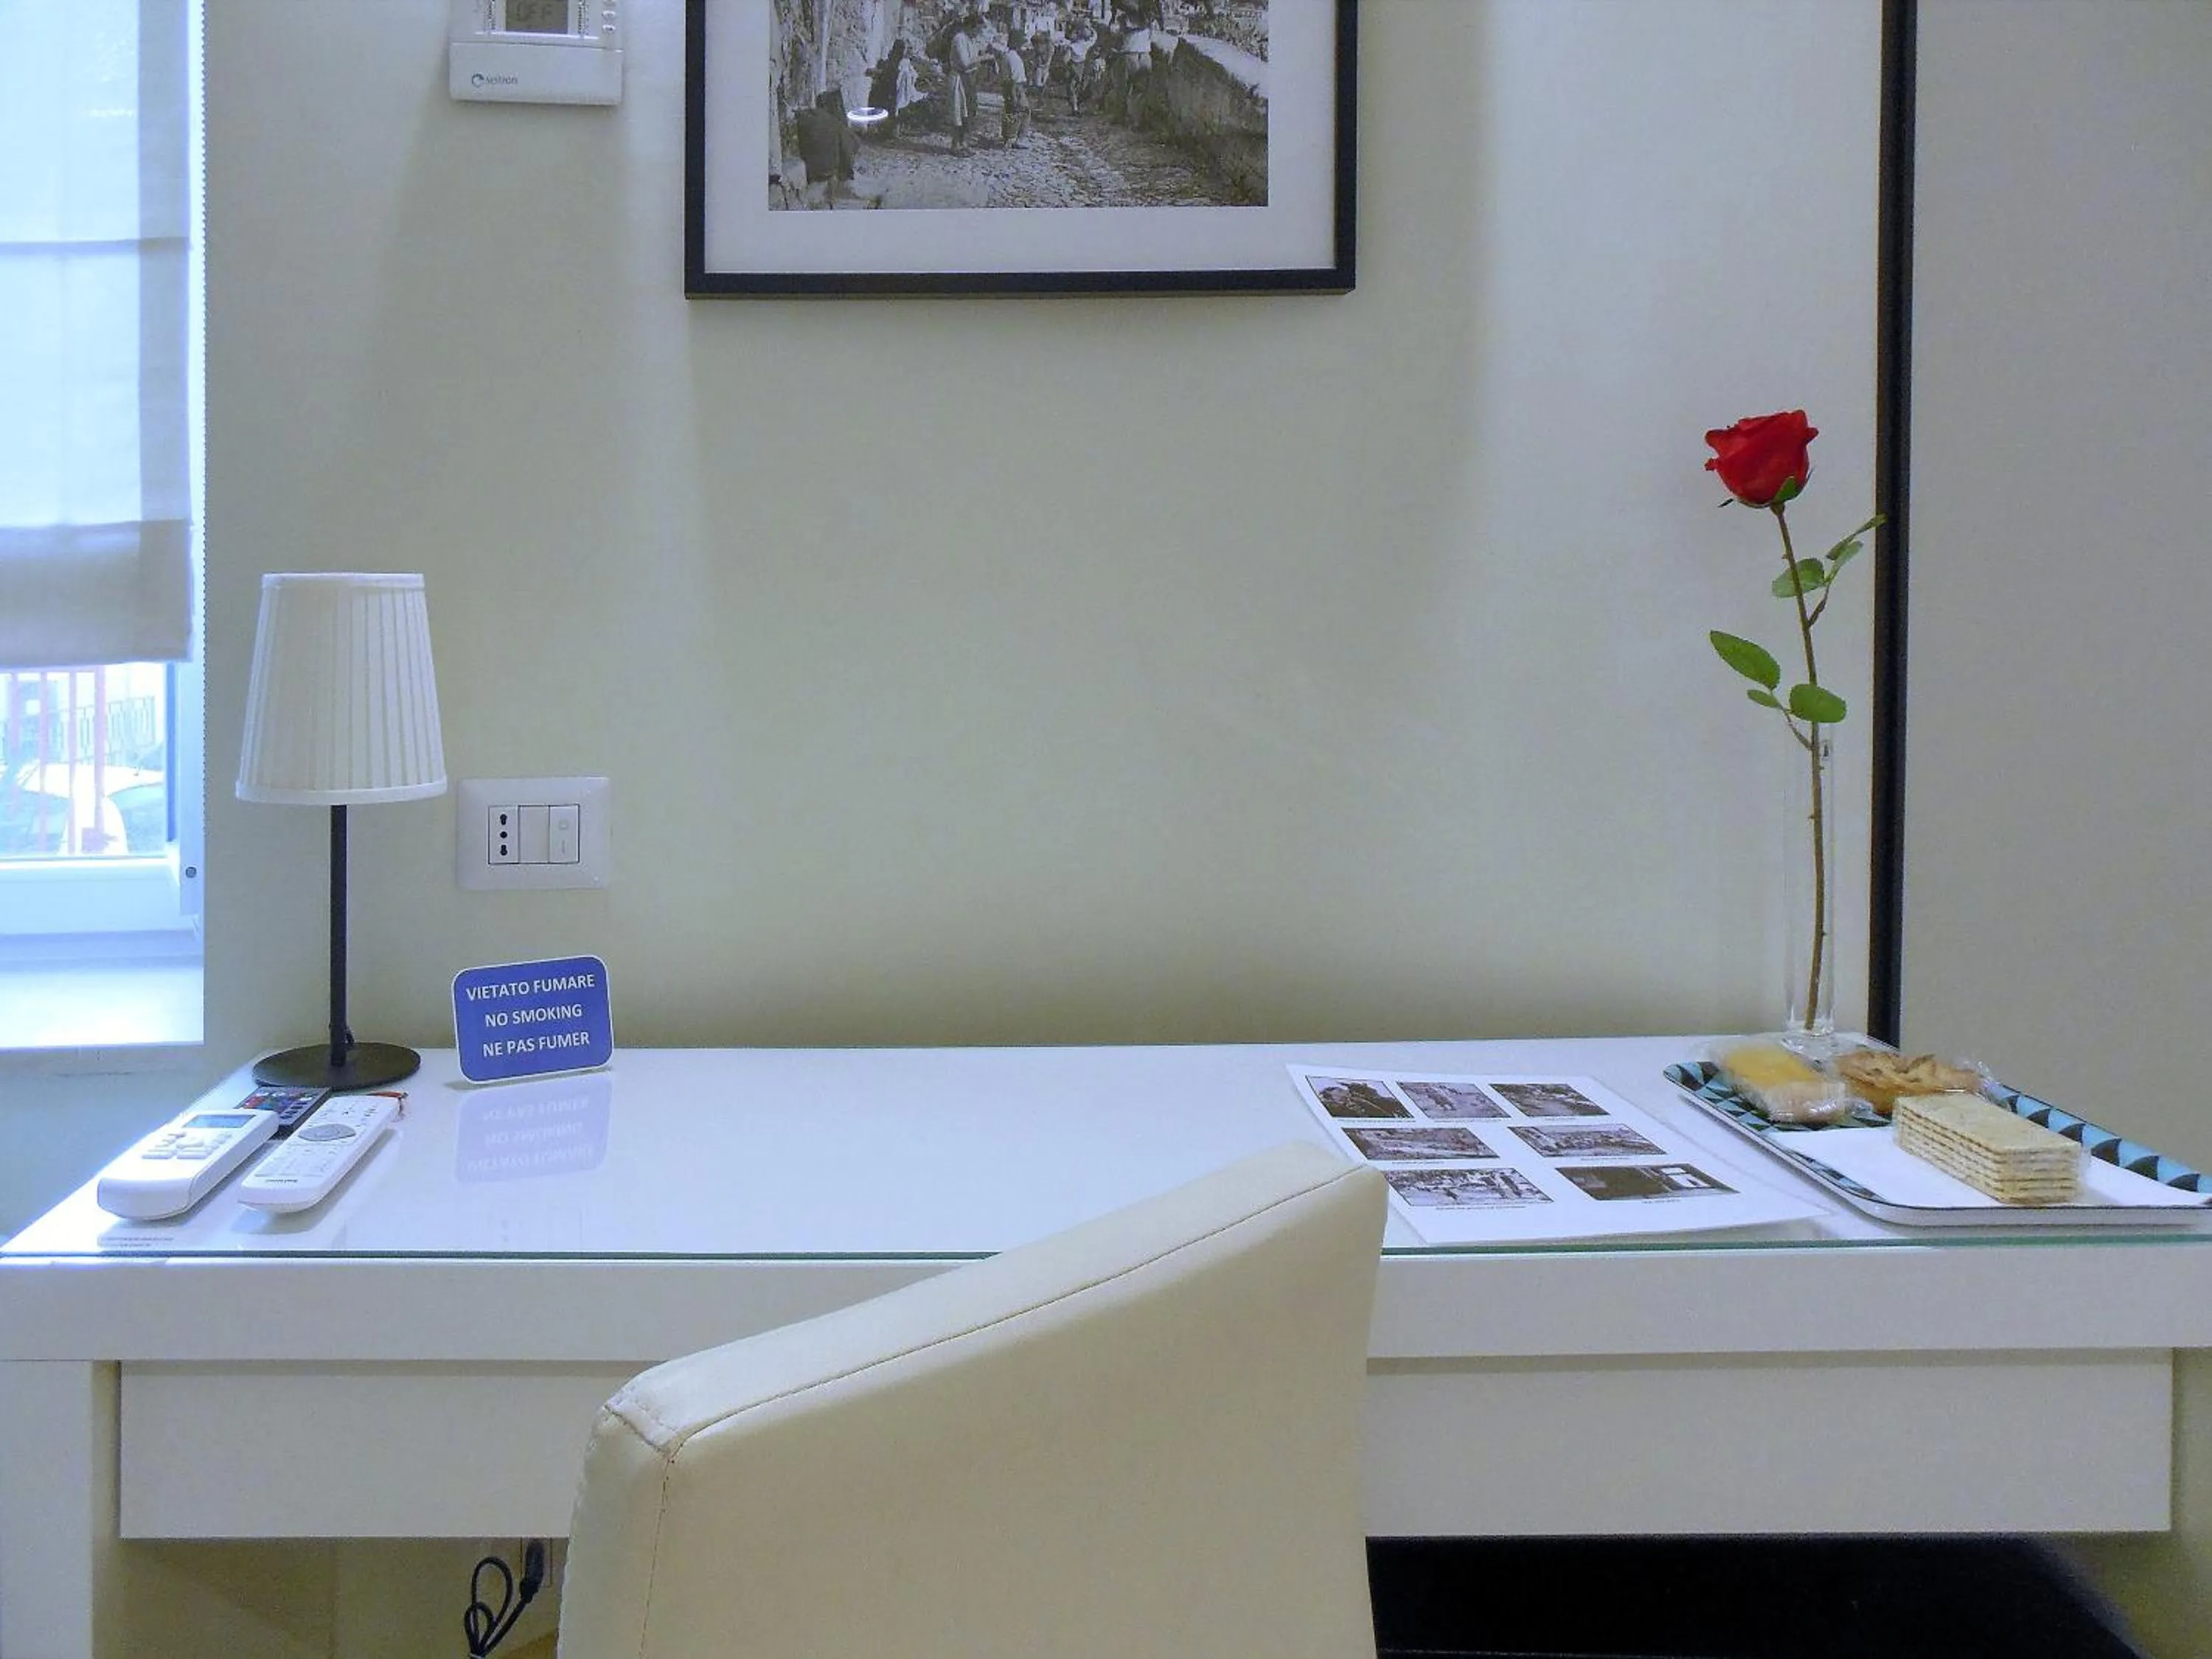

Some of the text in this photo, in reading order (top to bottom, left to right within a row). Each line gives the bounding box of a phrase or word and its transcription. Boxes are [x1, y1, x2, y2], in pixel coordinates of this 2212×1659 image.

[466, 974, 595, 1001] VIETATO FUMARE
[485, 1004, 582, 1027] NO SMOKING
[483, 1032, 590, 1057] NE PAS FUMER
